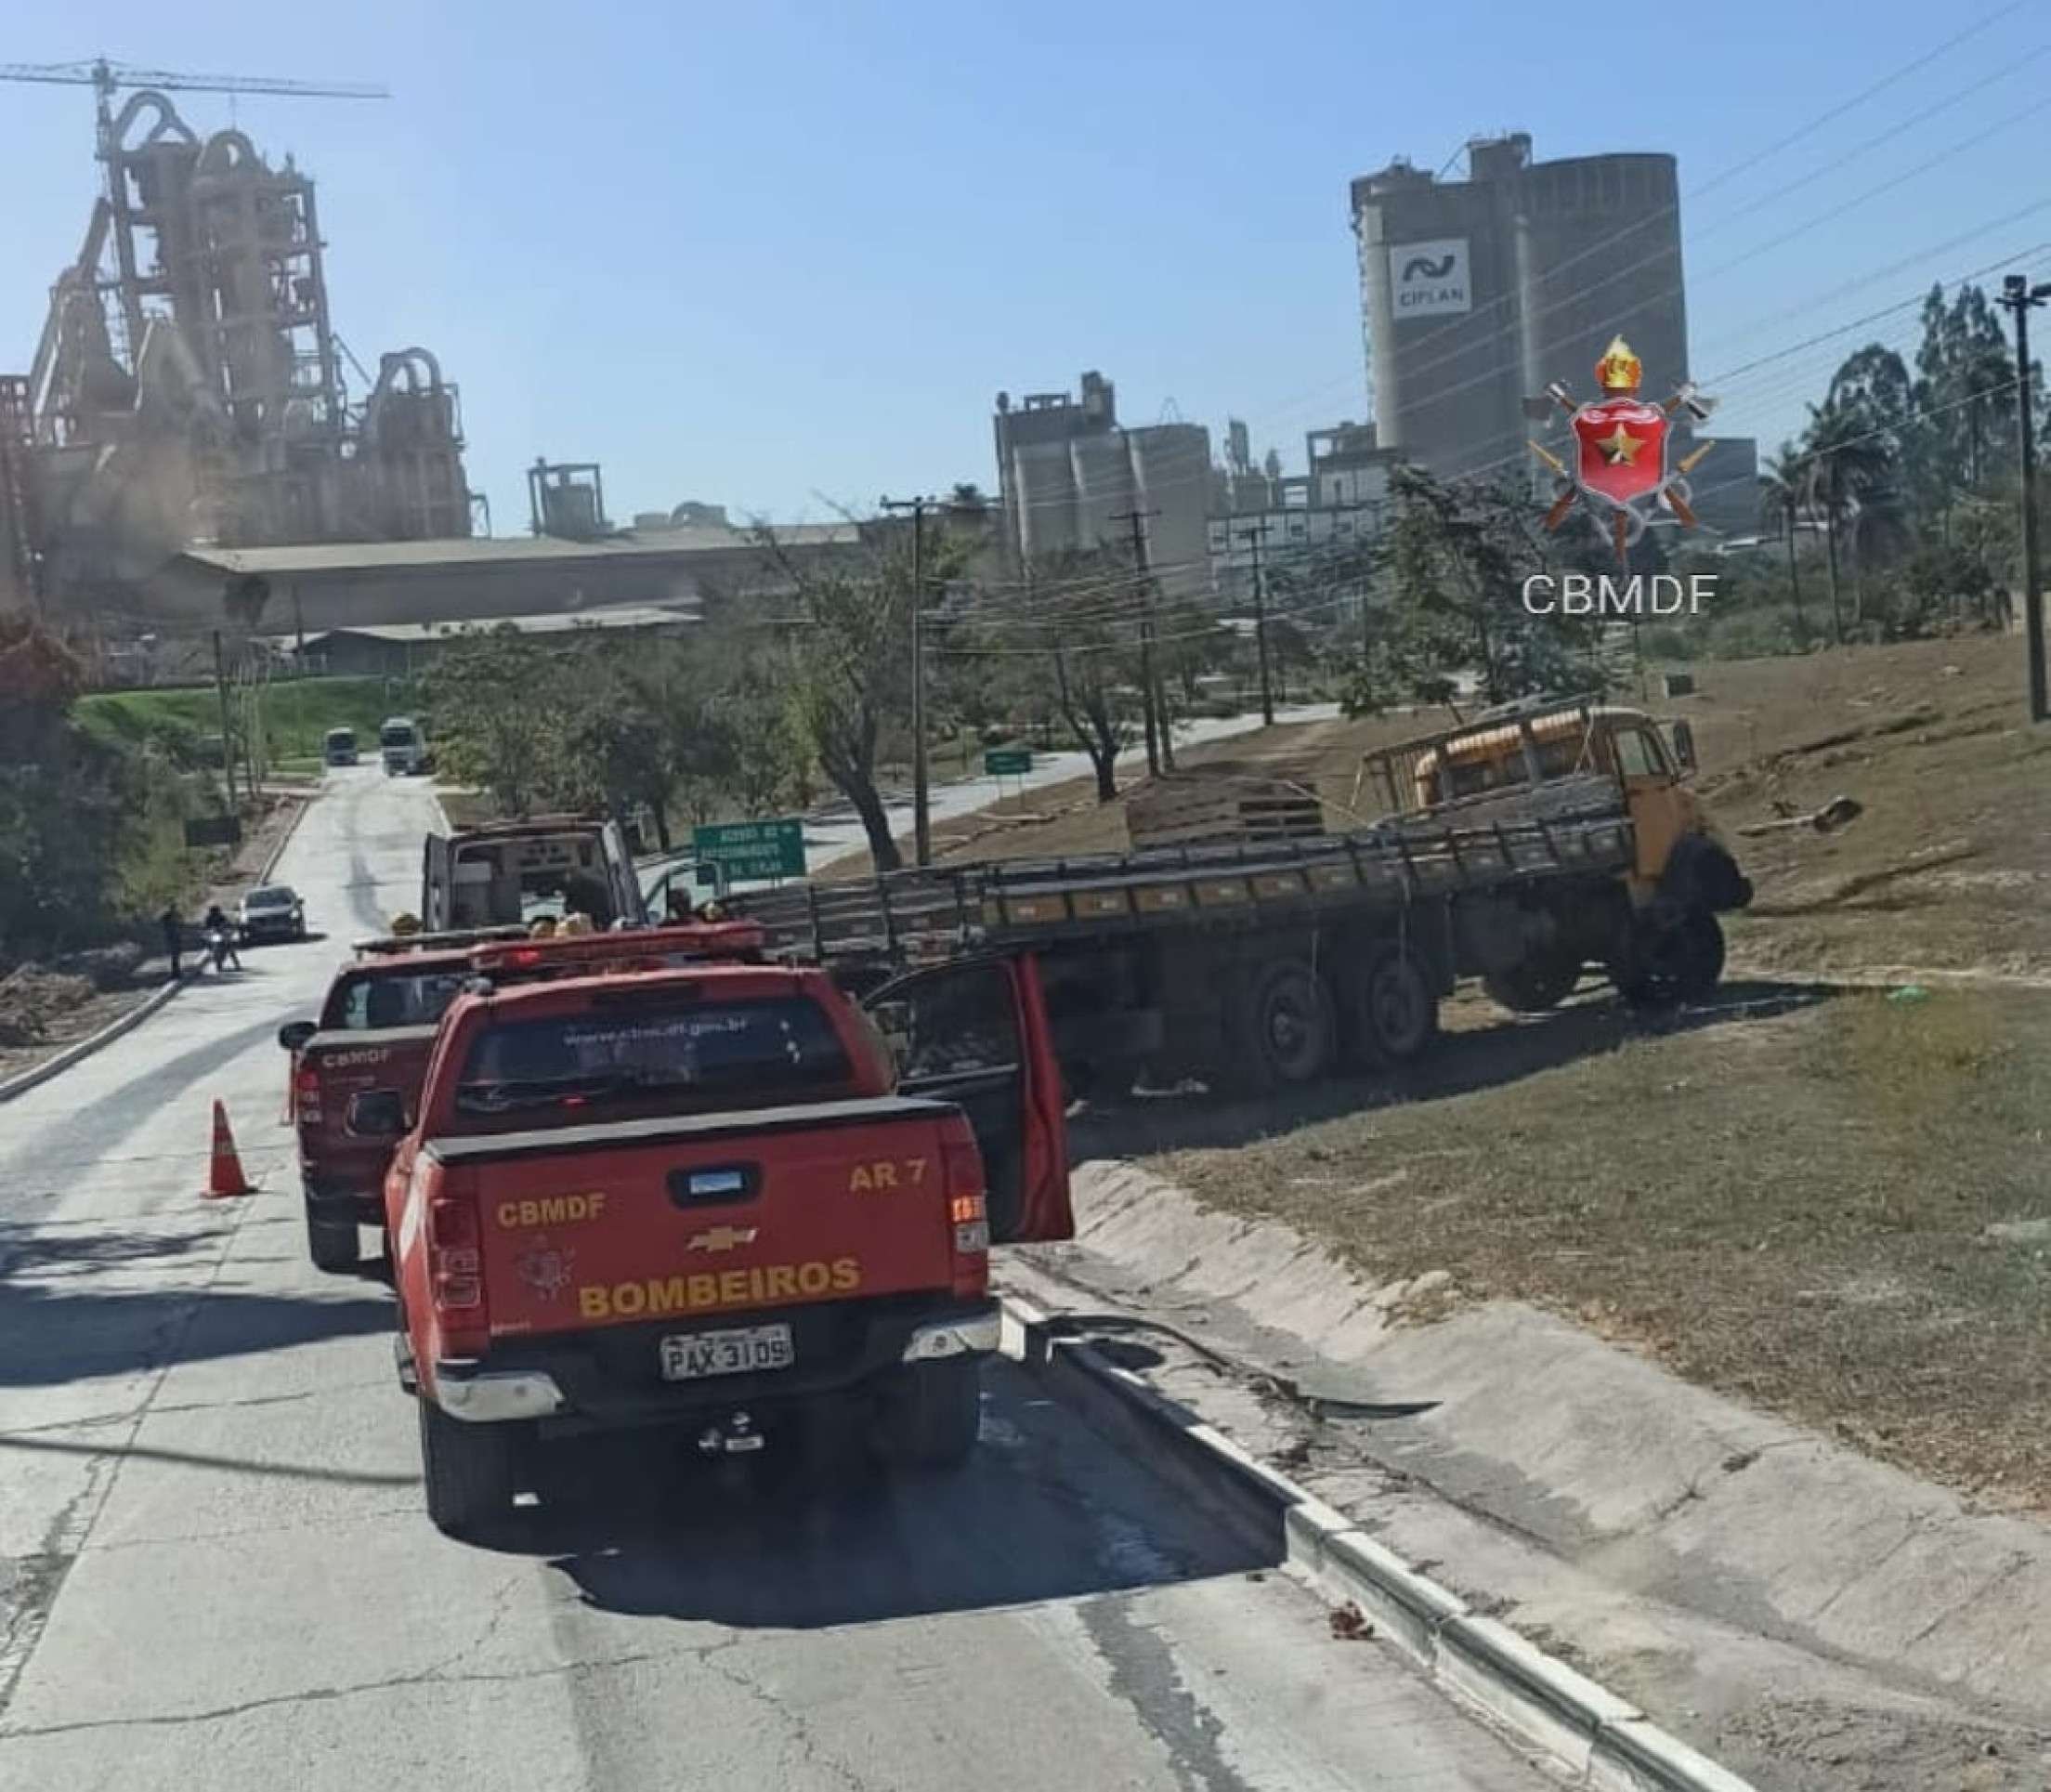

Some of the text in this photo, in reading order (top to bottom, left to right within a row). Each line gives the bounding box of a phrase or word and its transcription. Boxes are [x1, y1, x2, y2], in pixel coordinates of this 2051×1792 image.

[1400, 287, 1464, 307] CIPLAN
[320, 1048, 390, 1069] CBMDF
[849, 1158, 928, 1192] AR 7
[497, 1192, 607, 1228] CBMDF
[578, 1256, 861, 1318] BOMBEIROS
